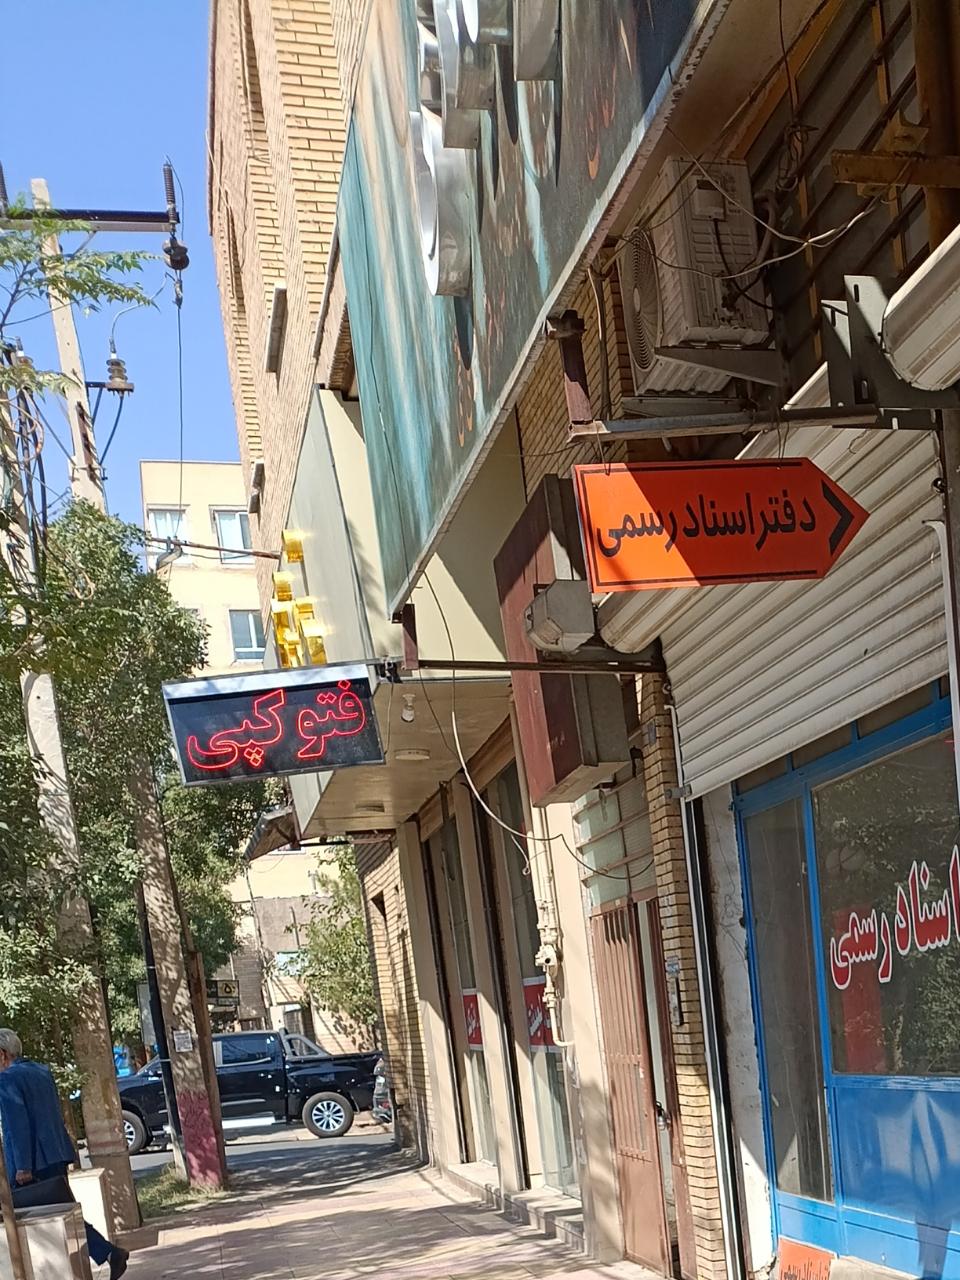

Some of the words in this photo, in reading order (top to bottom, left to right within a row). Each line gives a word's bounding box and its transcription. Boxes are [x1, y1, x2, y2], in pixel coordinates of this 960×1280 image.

[597, 511, 678, 557] رسمی
[682, 492, 755, 538] اسناد
[755, 489, 816, 550] دفتر
[830, 909, 892, 989] رسمی
